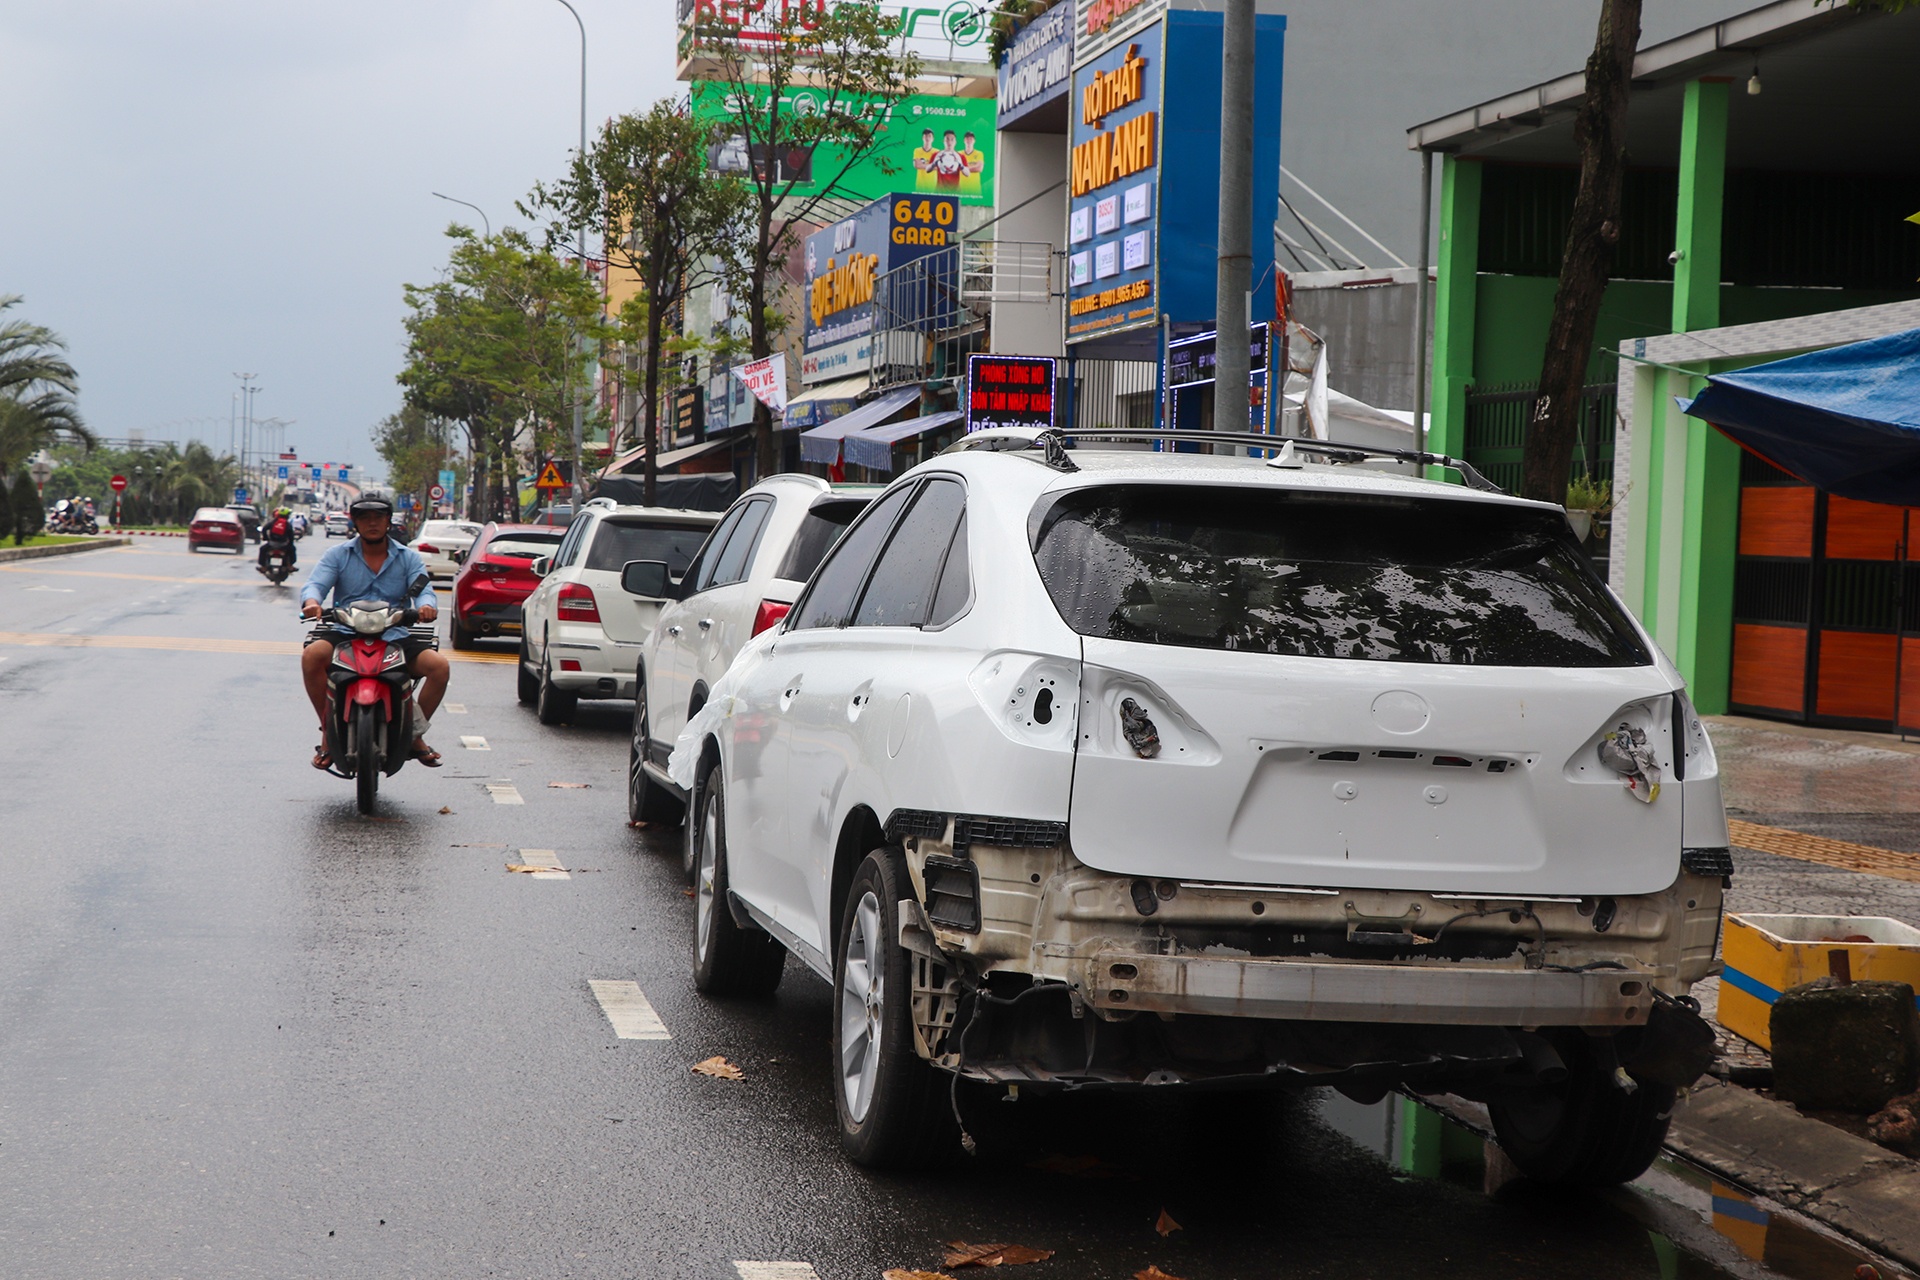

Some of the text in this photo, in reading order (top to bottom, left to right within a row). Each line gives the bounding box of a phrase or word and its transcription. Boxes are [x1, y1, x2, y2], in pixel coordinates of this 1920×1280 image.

[1045, 42, 1072, 90] ANH
[1083, 44, 1145, 130] NỘI THẤT
[1071, 111, 1155, 198] NAM ANH
[894, 199, 954, 225] 640
[833, 219, 857, 254] AUTO
[891, 226, 946, 246] GARA
[810, 257, 836, 328] QUÊ
[744, 358, 771, 376] GARAGE
